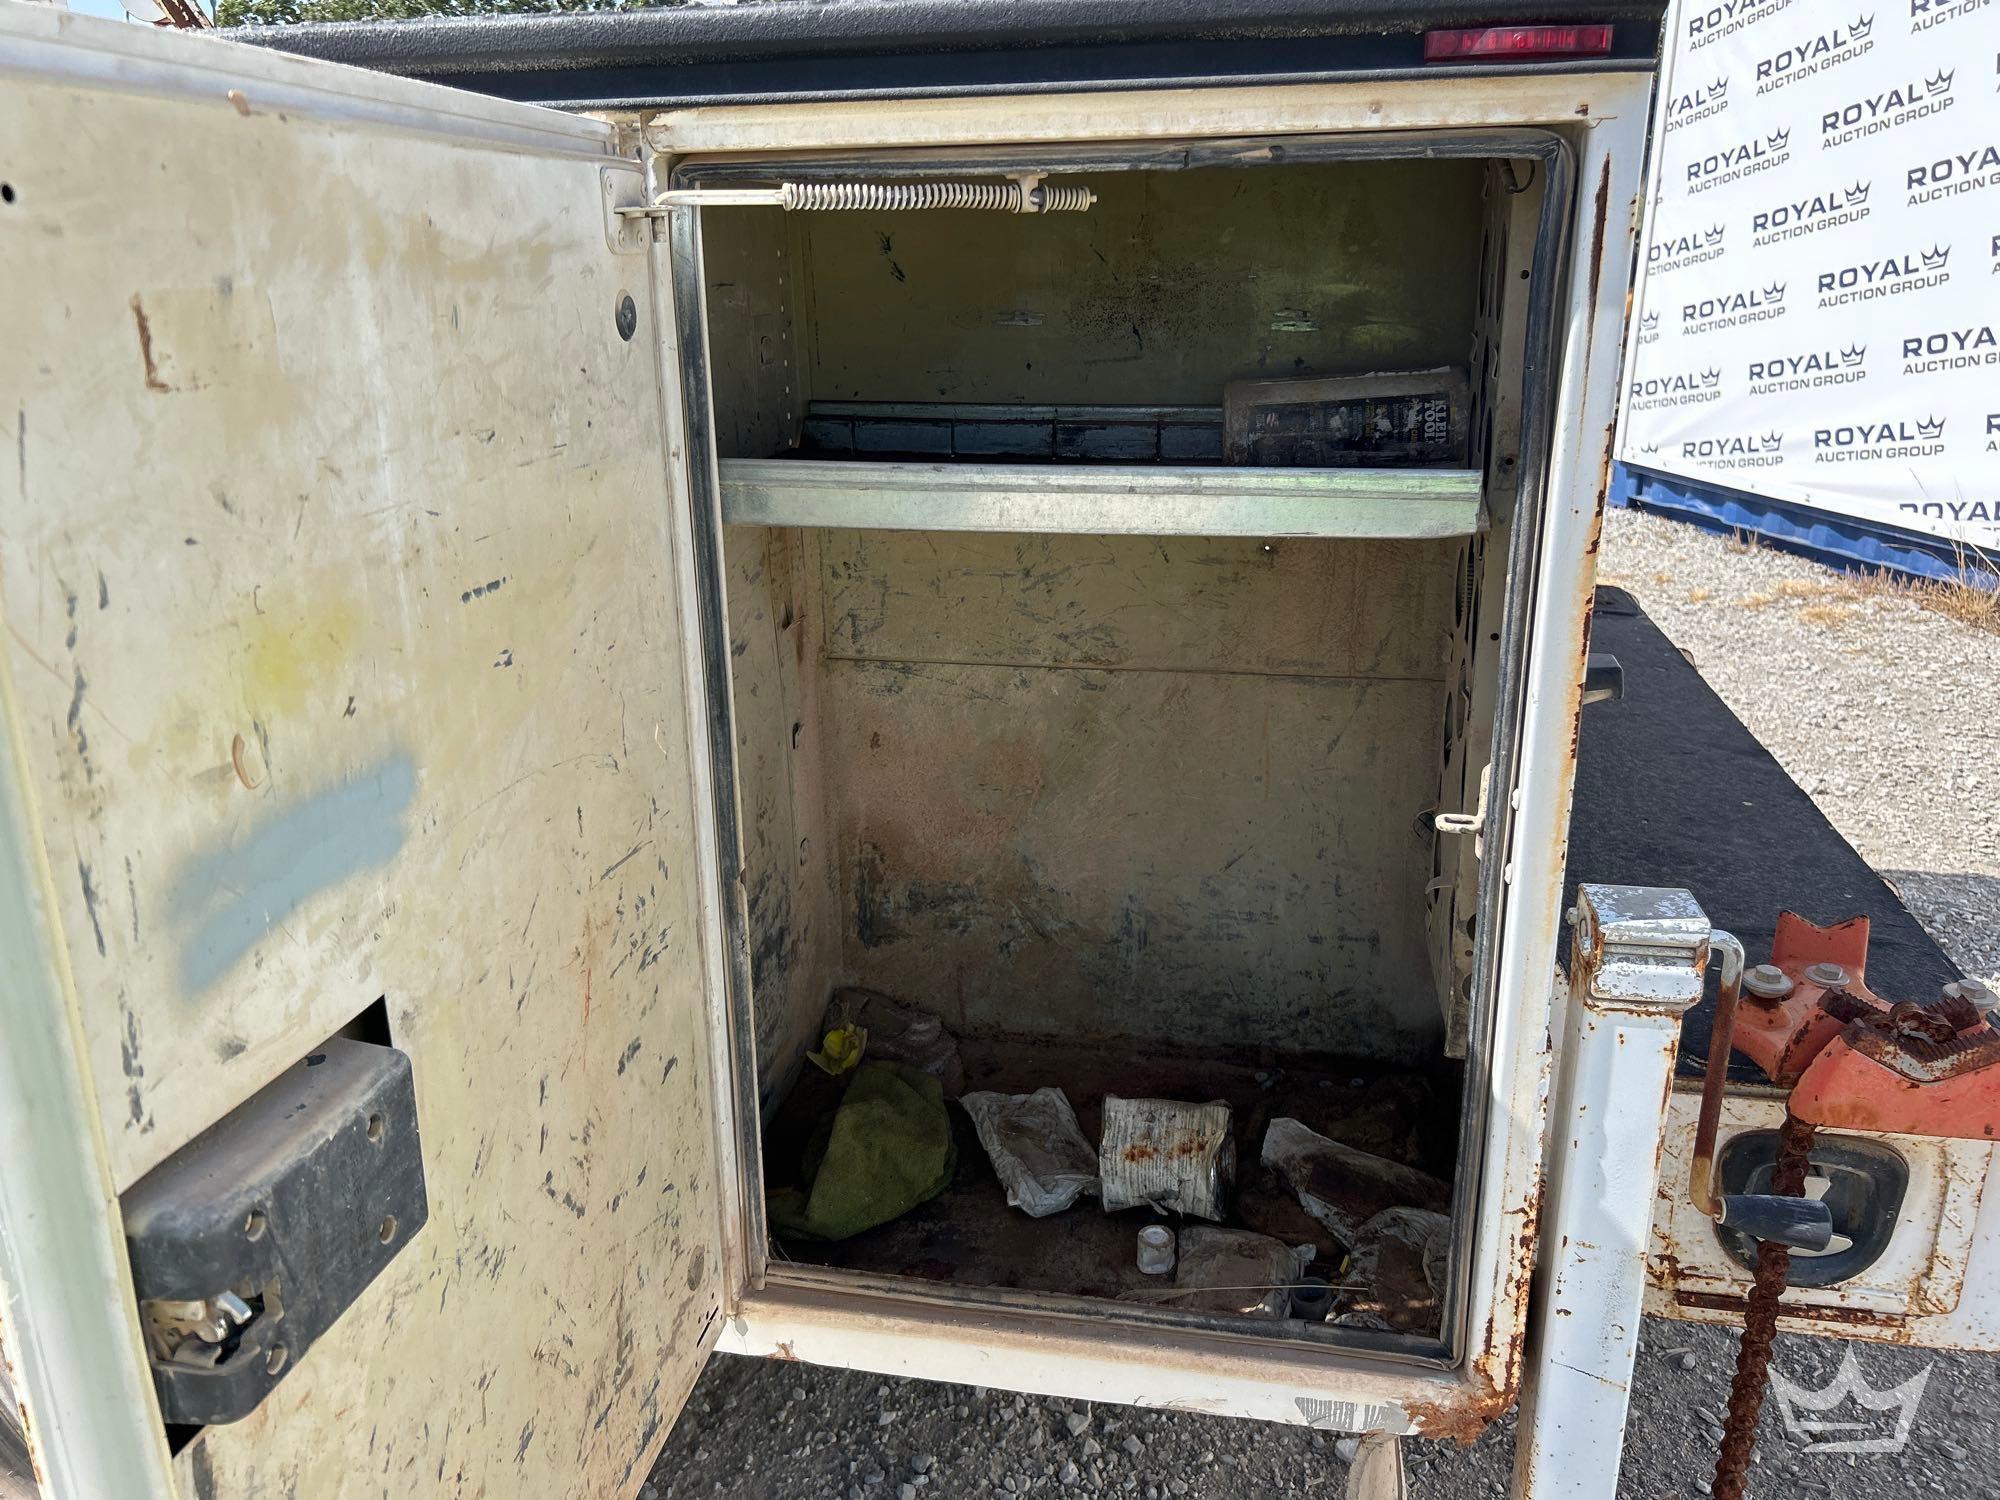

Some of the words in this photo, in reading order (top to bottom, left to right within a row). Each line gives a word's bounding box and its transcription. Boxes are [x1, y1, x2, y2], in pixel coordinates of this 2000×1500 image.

[1689, 0, 1768, 37] ROYA
[1689, 18, 1745, 52] AUCTION
[1756, 29, 1847, 81] ROYAL
[1756, 64, 1818, 96] AUCTION
[1821, 41, 1874, 71] GROUP
[1686, 100, 1728, 126] GROUP
[1822, 83, 1924, 135] ROYAL
[1822, 116, 1891, 150] AUCTION
[1894, 97, 1954, 126] GROUP
[1687, 139, 1766, 182] ROYAL
[1687, 169, 1740, 196] AUCTION
[1743, 152, 1790, 178] GROUP
[1907, 176, 1985, 207] AUCTION
[1752, 192, 1844, 234] ROYAL
[1752, 221, 1814, 248] AUCTION
[1817, 208, 1870, 232] GROUP
[1683, 247, 1724, 267] GROUP
[1818, 253, 1920, 293] ROYAL
[1683, 291, 1761, 322] ROYAL
[1818, 285, 1886, 309] AUCTION
[1890, 273, 1950, 295] GROUP
[1683, 317, 1736, 336] AUCTION
[1739, 306, 1785, 325] GROUP
[1903, 326, 1997, 358] ROYA
[1749, 352, 1838, 381] ROYAL
[1903, 354, 1980, 375] AUCTION
[1631, 374, 1699, 398] ROYAL
[1749, 379, 1809, 396] AUCTION
[1813, 370, 1866, 389] GROUP
[1630, 397, 1677, 411] AUCTION
[1679, 390, 1721, 404] GROUP
[1683, 437, 1759, 458] ROYAL
[1815, 422, 1914, 447] ROYAL
[1738, 455, 1783, 469] GROUP
[1815, 447, 1883, 463] AUCTION
[1886, 444, 1944, 461] GROUP
